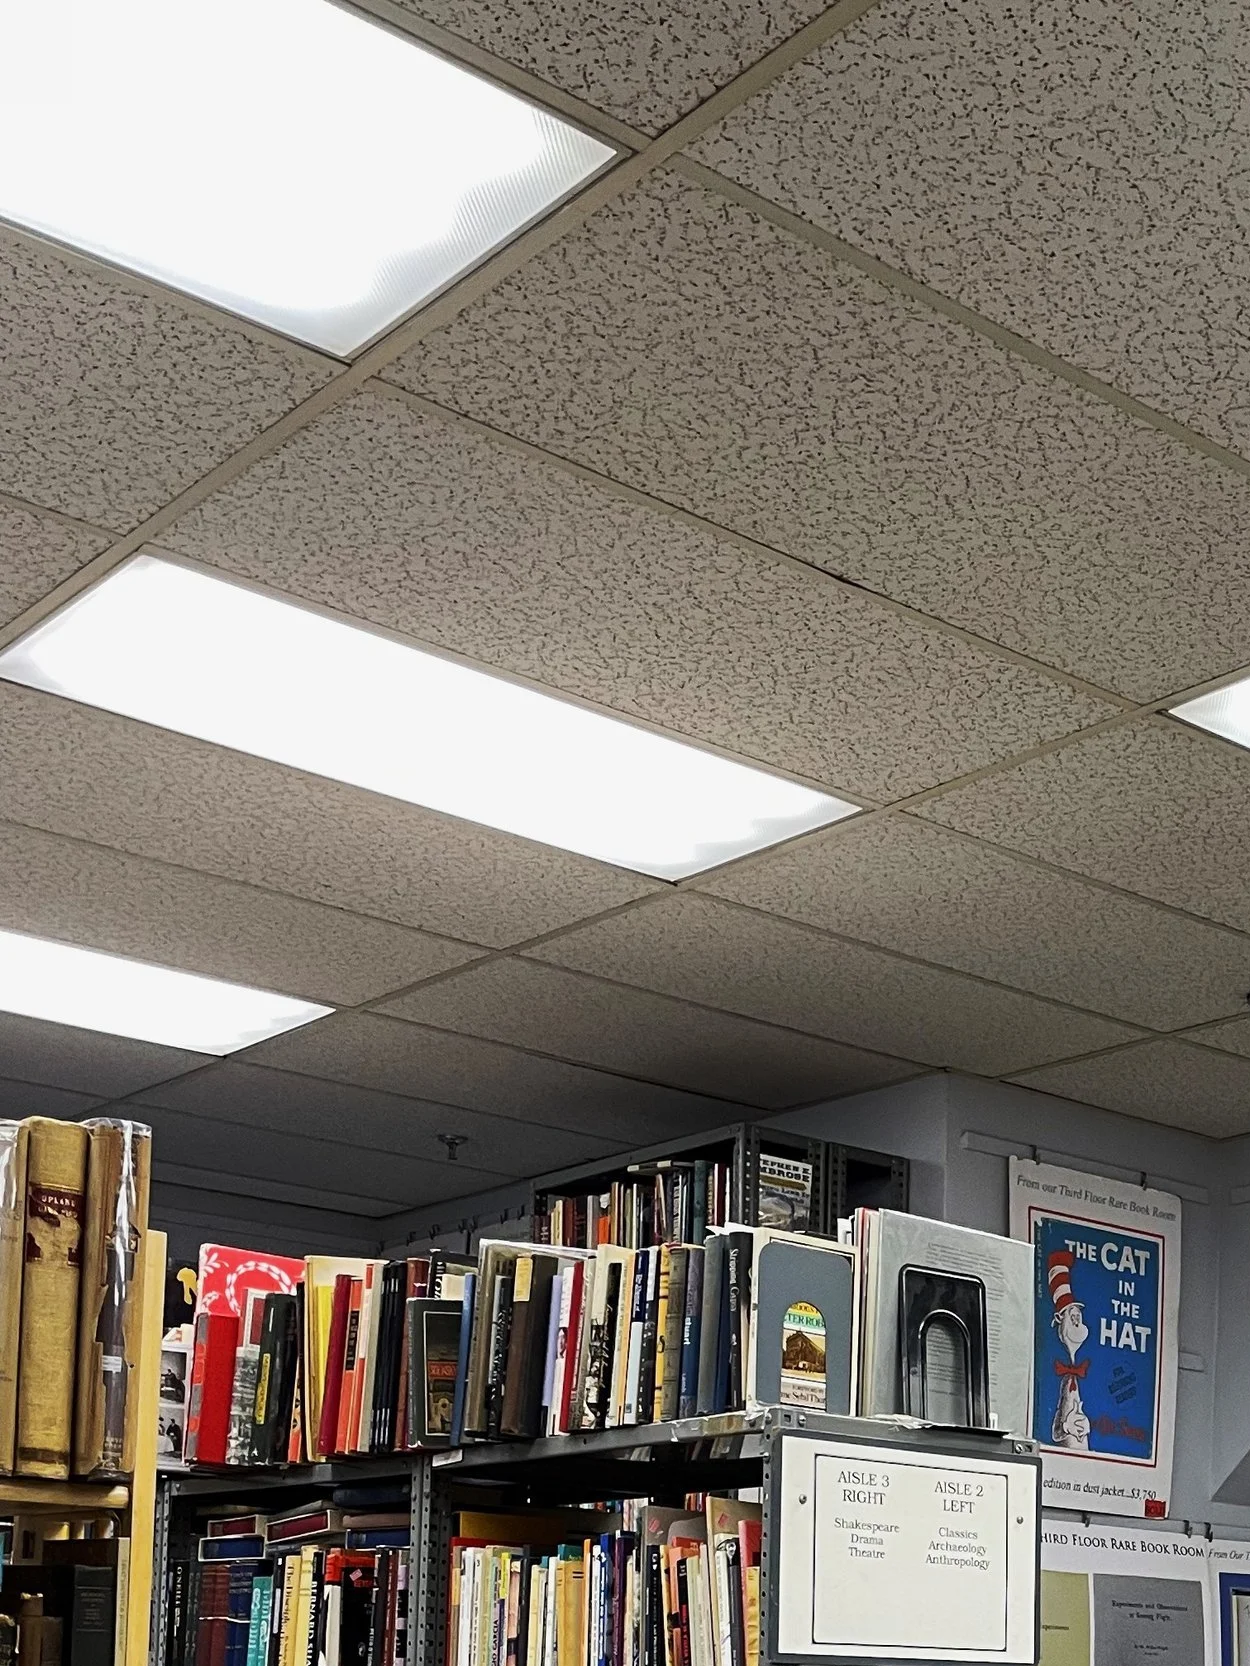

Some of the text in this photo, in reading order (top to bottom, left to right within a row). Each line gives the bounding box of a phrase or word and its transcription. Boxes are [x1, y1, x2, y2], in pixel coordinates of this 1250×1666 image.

[1065, 1239, 1150, 1277] THE CAT
[1118, 1280, 1135, 1296] IN
[1111, 1299, 1140, 1319] THE
[1099, 1318, 1152, 1354] HAT
[837, 1470, 890, 1488] AISLE 3
[842, 1489, 886, 1506] RIGHT
[934, 1480, 984, 1498] AISLE 2
[942, 1499, 976, 1514] LEFT
[833, 1517, 900, 1535] Shakespeare
[938, 1526, 978, 1540] Classics
[850, 1533, 884, 1546] Drama
[928, 1540, 987, 1556] Archaeology
[848, 1546, 886, 1560] Theatre
[925, 1553, 991, 1571] Anthropology
